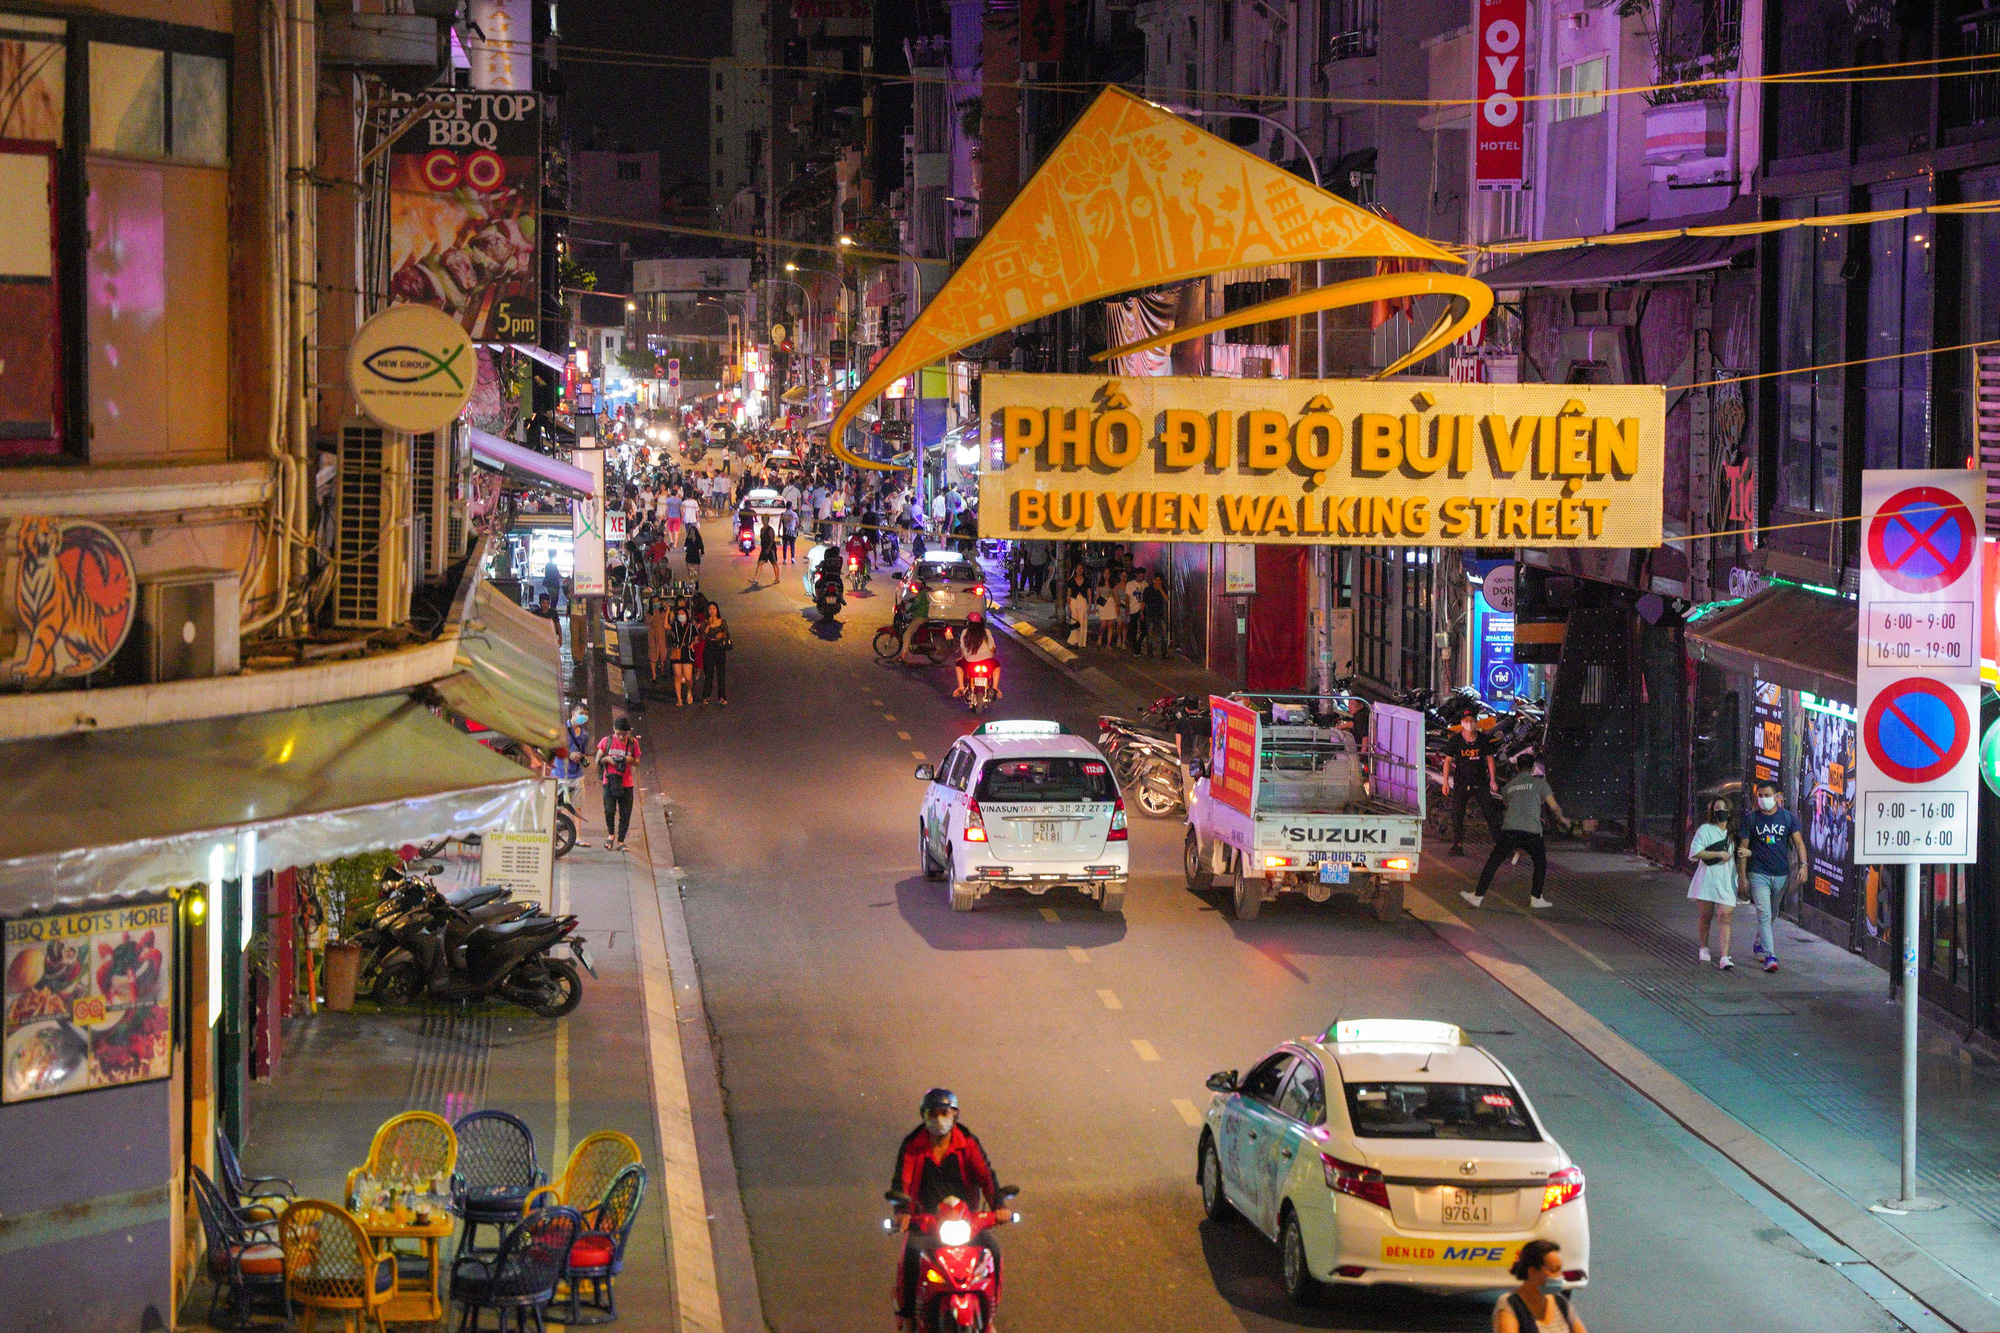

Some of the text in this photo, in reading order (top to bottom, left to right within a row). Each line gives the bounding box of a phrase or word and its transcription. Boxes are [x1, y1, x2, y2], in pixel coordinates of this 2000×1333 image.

[1483, 18, 1521, 128] OYO
[391, 92, 536, 122] ROOFTOP
[428, 119, 498, 150] BBQ
[1480, 141, 1520, 151] HOTEL
[497, 303, 535, 337] 5pm
[377, 359, 431, 369] NEW GROUP
[1449, 357, 1480, 383] HOTEL
[1003, 382, 1639, 492] PHỐ ĐI BỘ BÙI VIỆN
[1018, 490, 1611, 535] BUI VIEN WALKING STREET
[611, 516, 625, 533] XE
[1884, 613, 1913, 630] 6:00
[1927, 613, 1956, 630] 9:00
[1876, 641, 1911, 659] 16:00
[1925, 641, 1961, 659] 19:00
[981, 804, 1114, 813] VINASUN TAXI 38.27 27 27
[1877, 802, 1905, 819] 9:00
[1920, 802, 1955, 819] 16:00
[490, 833, 550, 843] TIP INCLUDED
[1289, 828, 1387, 844] SUZUKI
[1755, 824, 1786, 836] LAKE
[1876, 830, 1910, 847] 19:00
[1925, 830, 1953, 847] 6:00
[5, 906, 169, 942] BBQ & LOTS MORE
[1413, 1247, 1435, 1259] LED
[1442, 1246, 1506, 1261] MPE
